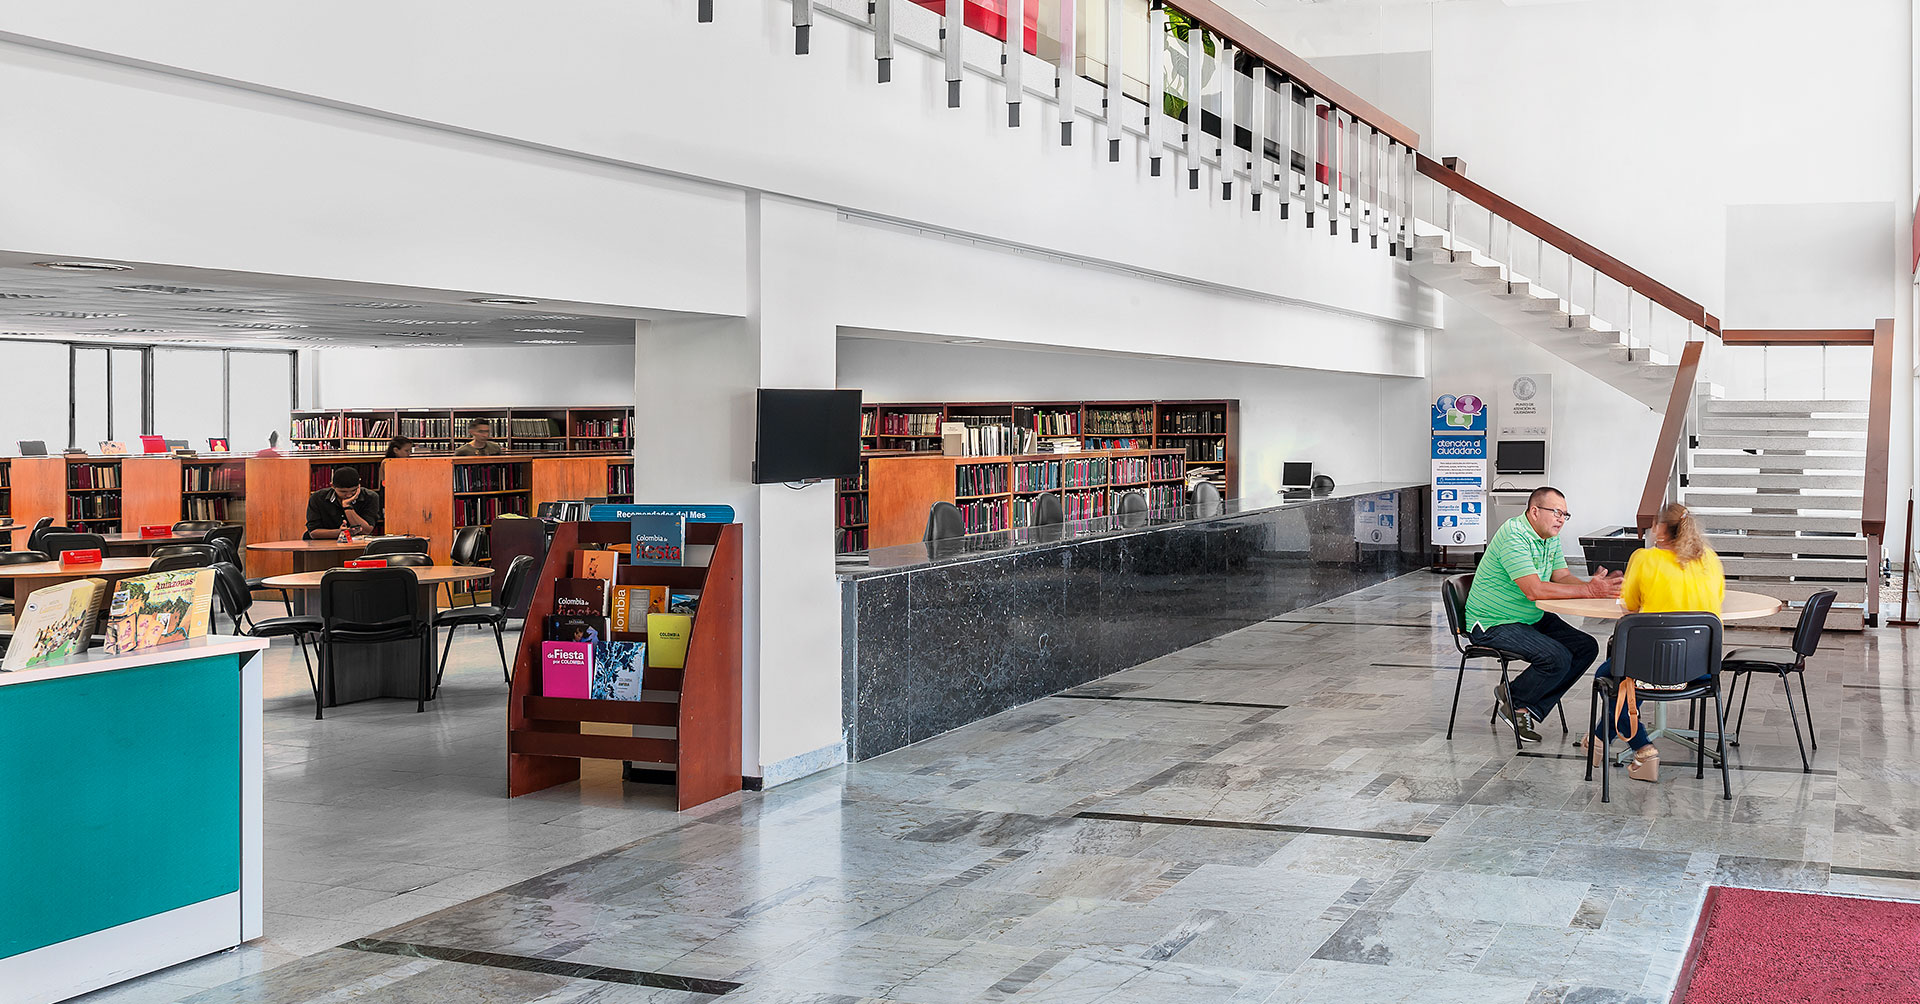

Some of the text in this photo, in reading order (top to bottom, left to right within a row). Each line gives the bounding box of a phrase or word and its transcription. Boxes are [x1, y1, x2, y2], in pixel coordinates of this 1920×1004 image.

[1437, 447, 1482, 455] ciudadano
[689, 511, 707, 519] Mes
[636, 534, 664, 542] Colombia
[635, 541, 681, 560] fiesta
[558, 597, 585, 606] Colombia
[613, 589, 627, 632] lombia
[553, 649, 584, 660] Fiesta
